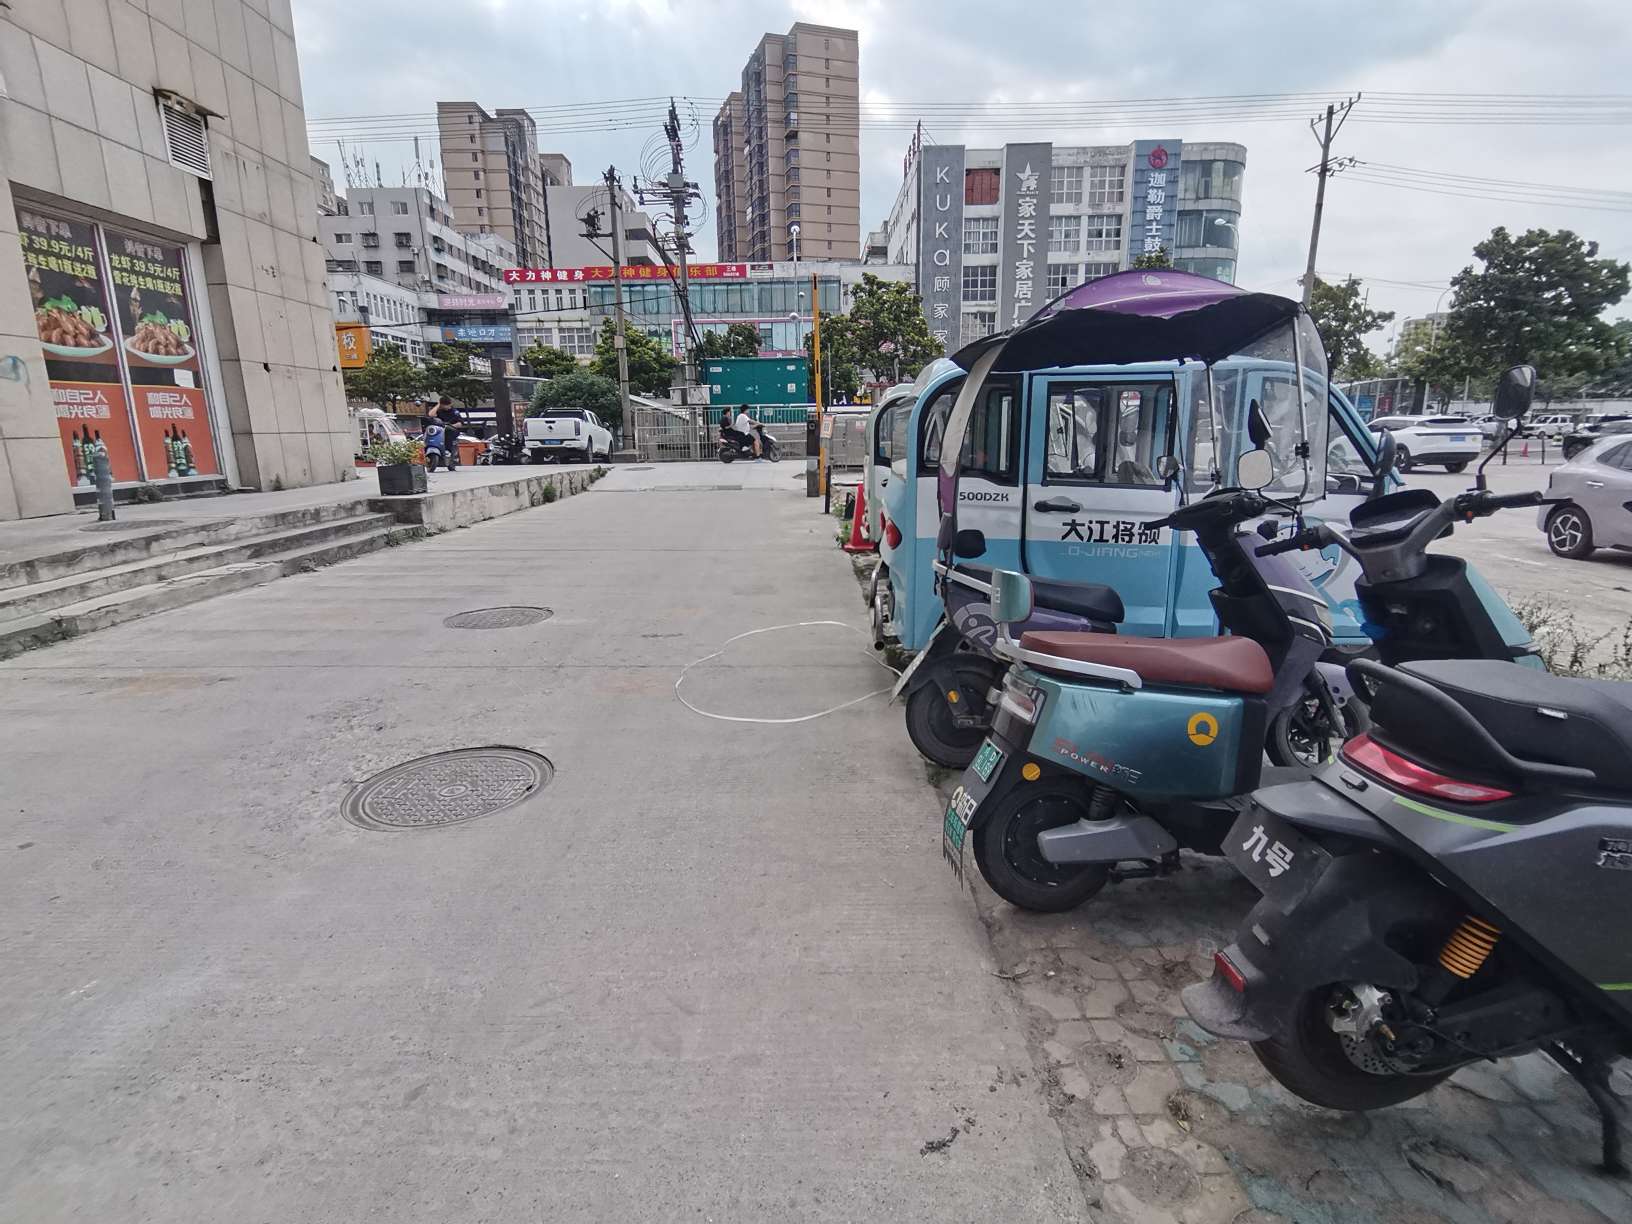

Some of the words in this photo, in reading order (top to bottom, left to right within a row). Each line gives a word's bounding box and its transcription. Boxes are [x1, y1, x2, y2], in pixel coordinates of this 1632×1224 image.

[1143, 172, 1167, 257] 迦勒爵士鼓
[133, 259, 181, 281] 39.9元/4斤
[508, 270, 585, 281] 大力神健身
[1242, 825, 1295, 877] 九号
